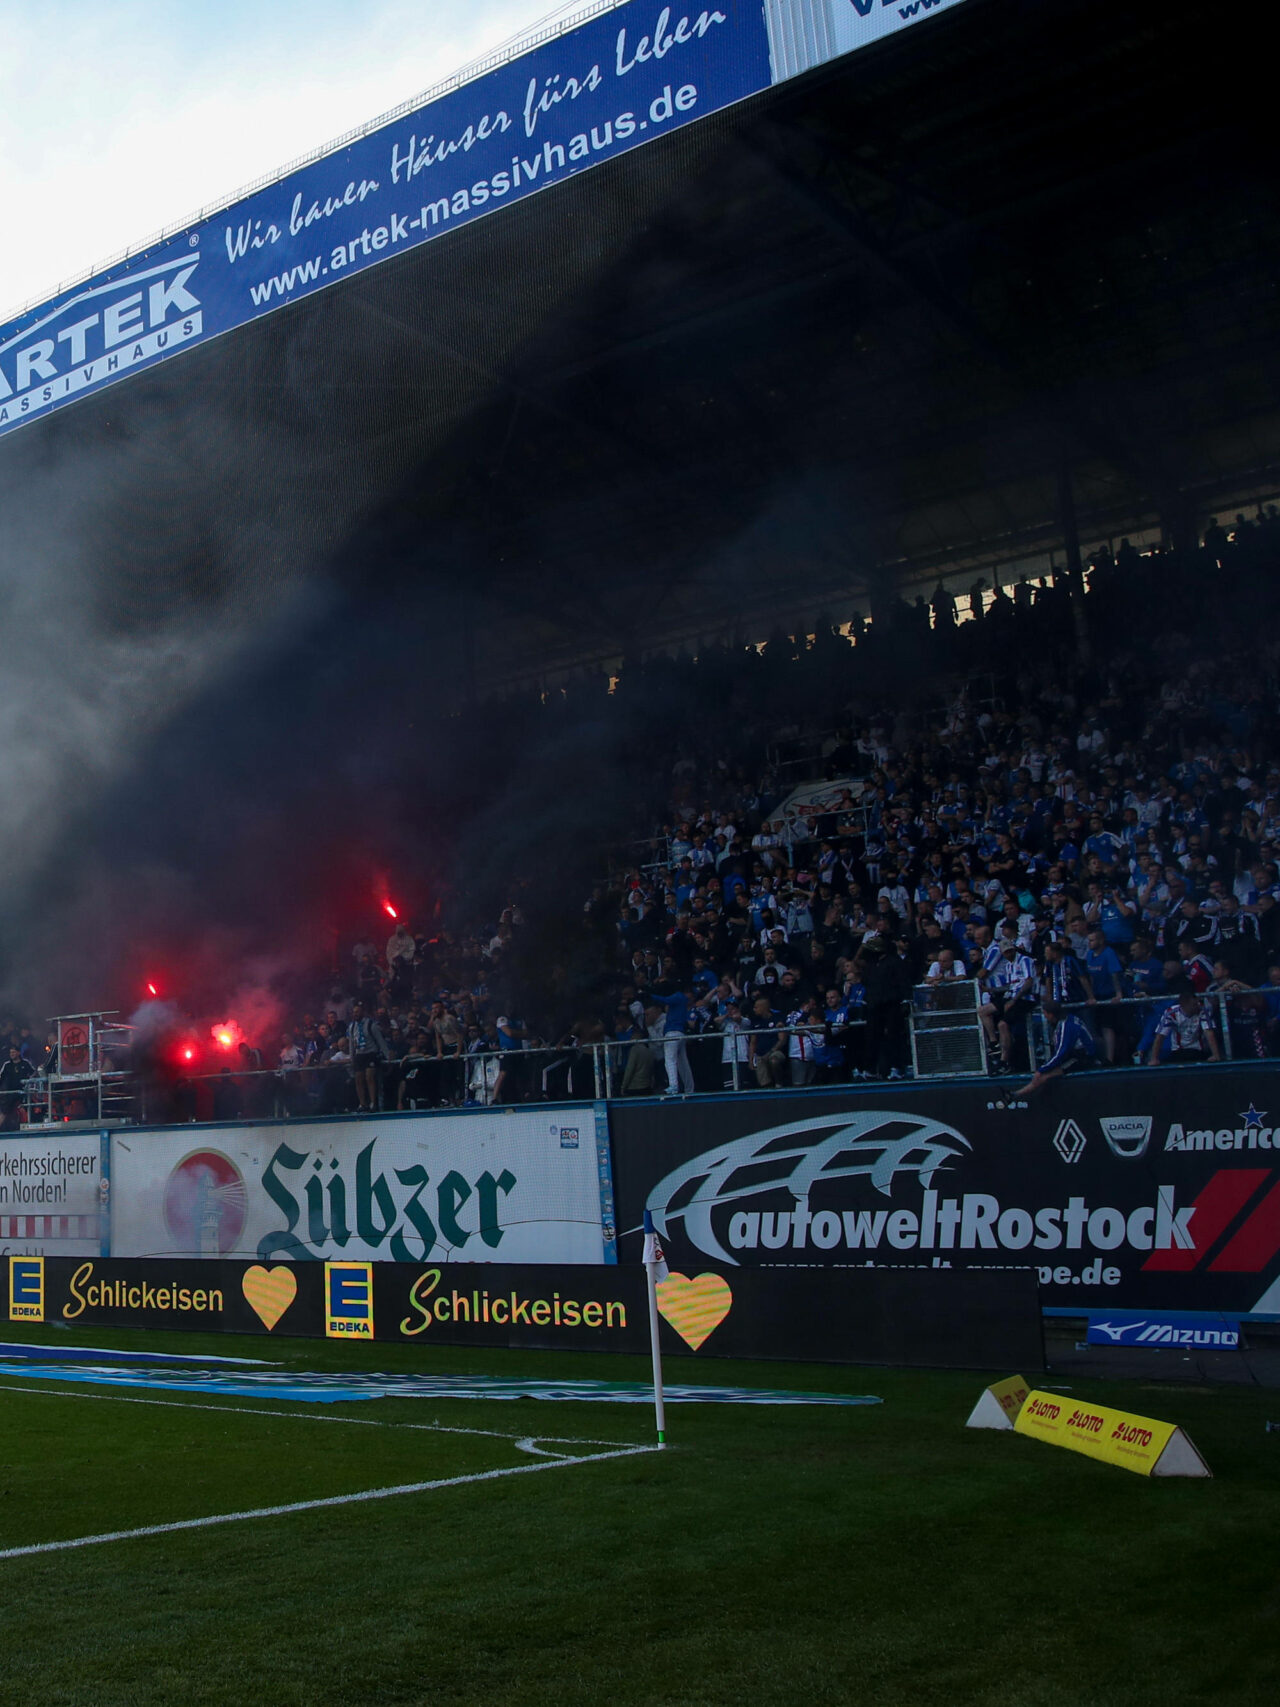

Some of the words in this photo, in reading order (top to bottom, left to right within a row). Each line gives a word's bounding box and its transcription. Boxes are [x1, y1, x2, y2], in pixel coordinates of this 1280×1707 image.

[225, 220, 281, 263] Wir
[289, 177, 379, 236] bauen
[390, 109, 512, 184] Häuser
[524, 64, 601, 138] fürs
[616, 6, 727, 78] Leben
[250, 83, 698, 306] www.artek-massivhaus.de
[1109, 1122, 1145, 1131] DACIA
[12, 1178, 67, 1203] Norden!
[258, 1136, 517, 1262] Lübzer
[727, 1185, 1197, 1250] autoweltRostock
[63, 1262, 223, 1319] Schlickeisen
[400, 1268, 626, 1336] Schlickeisen
[12, 1307, 41, 1317] EDEKA
[329, 1321, 371, 1334] EDEKA
[1036, 1402, 1060, 1420] LOTTO
[1078, 1414, 1104, 1433] LOTTO
[1124, 1426, 1152, 1447] LOTTO
